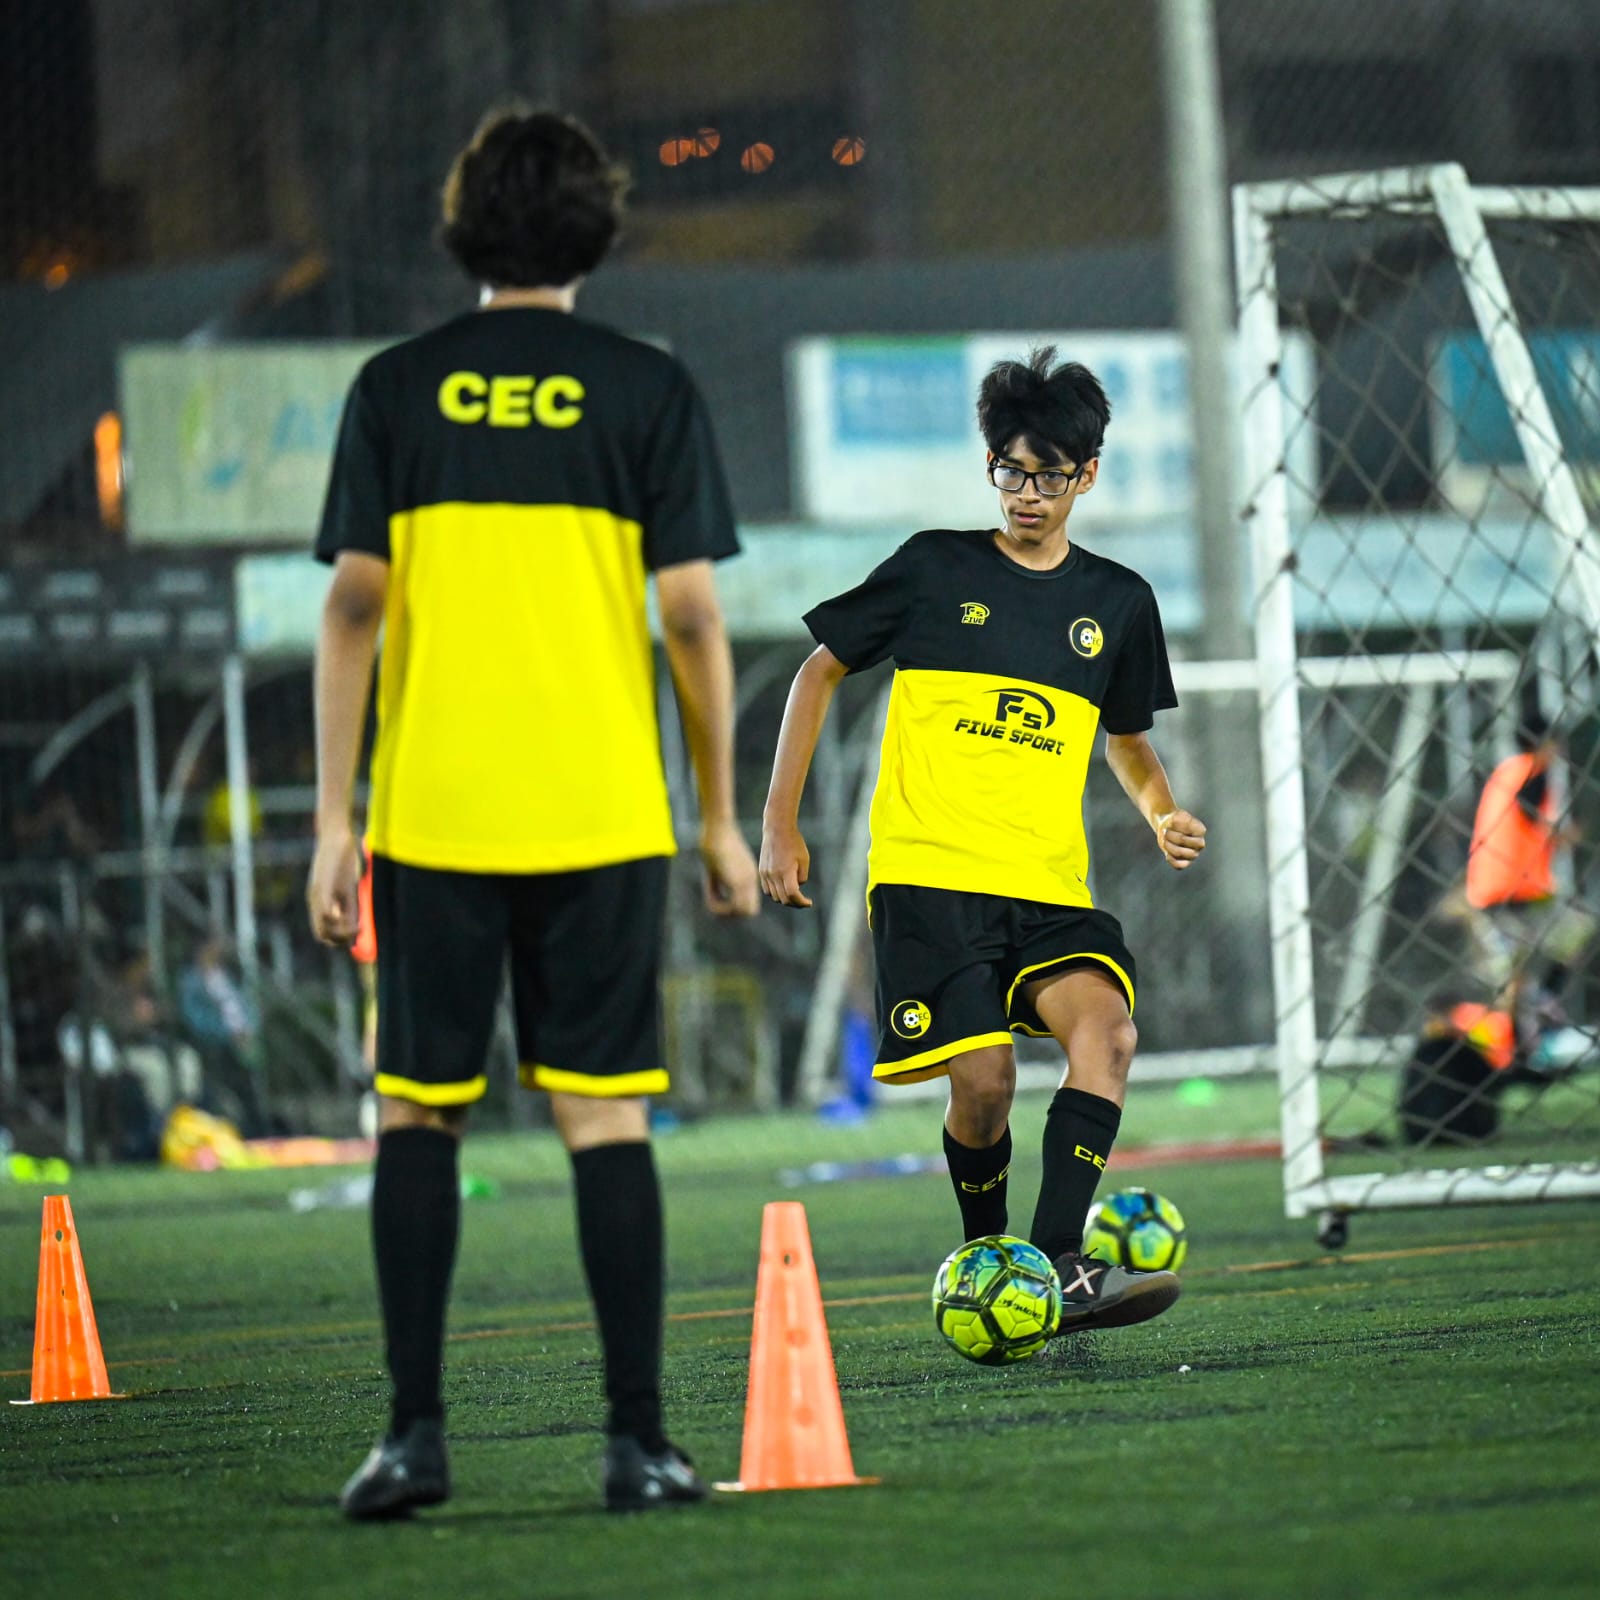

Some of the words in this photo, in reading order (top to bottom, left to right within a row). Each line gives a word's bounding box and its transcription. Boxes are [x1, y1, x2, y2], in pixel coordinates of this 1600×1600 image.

[438, 371, 585, 428] CEC
[961, 616, 985, 625] FIVE
[954, 718, 1006, 739] FIVE
[1008, 729, 1065, 756] SPORT
